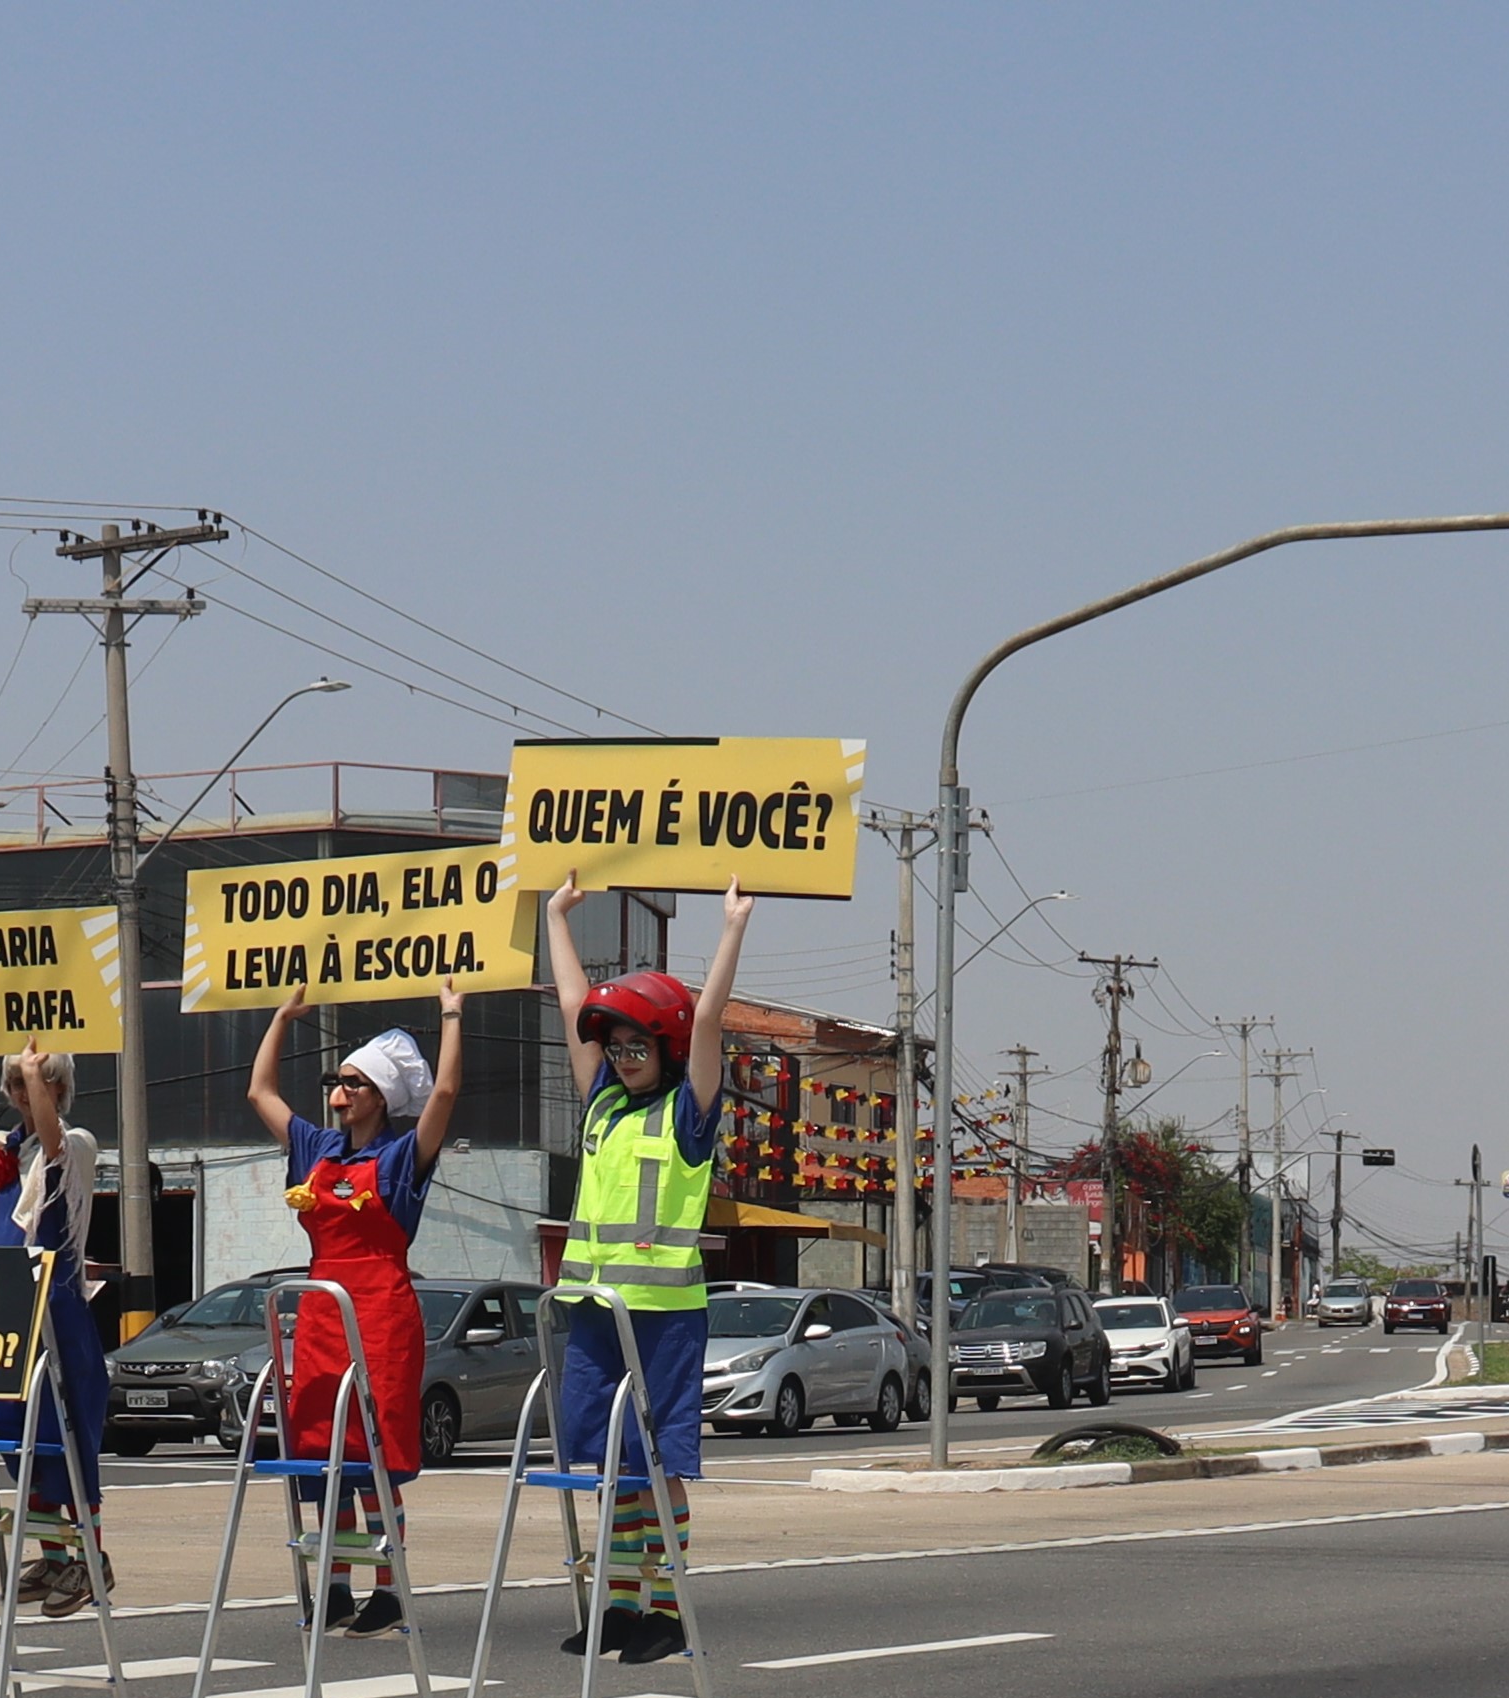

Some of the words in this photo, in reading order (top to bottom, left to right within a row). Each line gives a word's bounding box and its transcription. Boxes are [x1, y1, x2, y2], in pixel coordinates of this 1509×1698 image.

[529, 789, 643, 844] QUEM
[656, 780, 682, 845] É
[699, 782, 832, 850] VOCÊ?
[222, 878, 308, 922] TODO
[323, 872, 388, 916] DIA,
[403, 865, 462, 909] ELA
[475, 861, 498, 904] O
[226, 942, 307, 989] LEVA
[320, 934, 341, 983] À
[355, 932, 483, 981] ESCOLA.
[5, 990, 84, 1031] RAFA.
